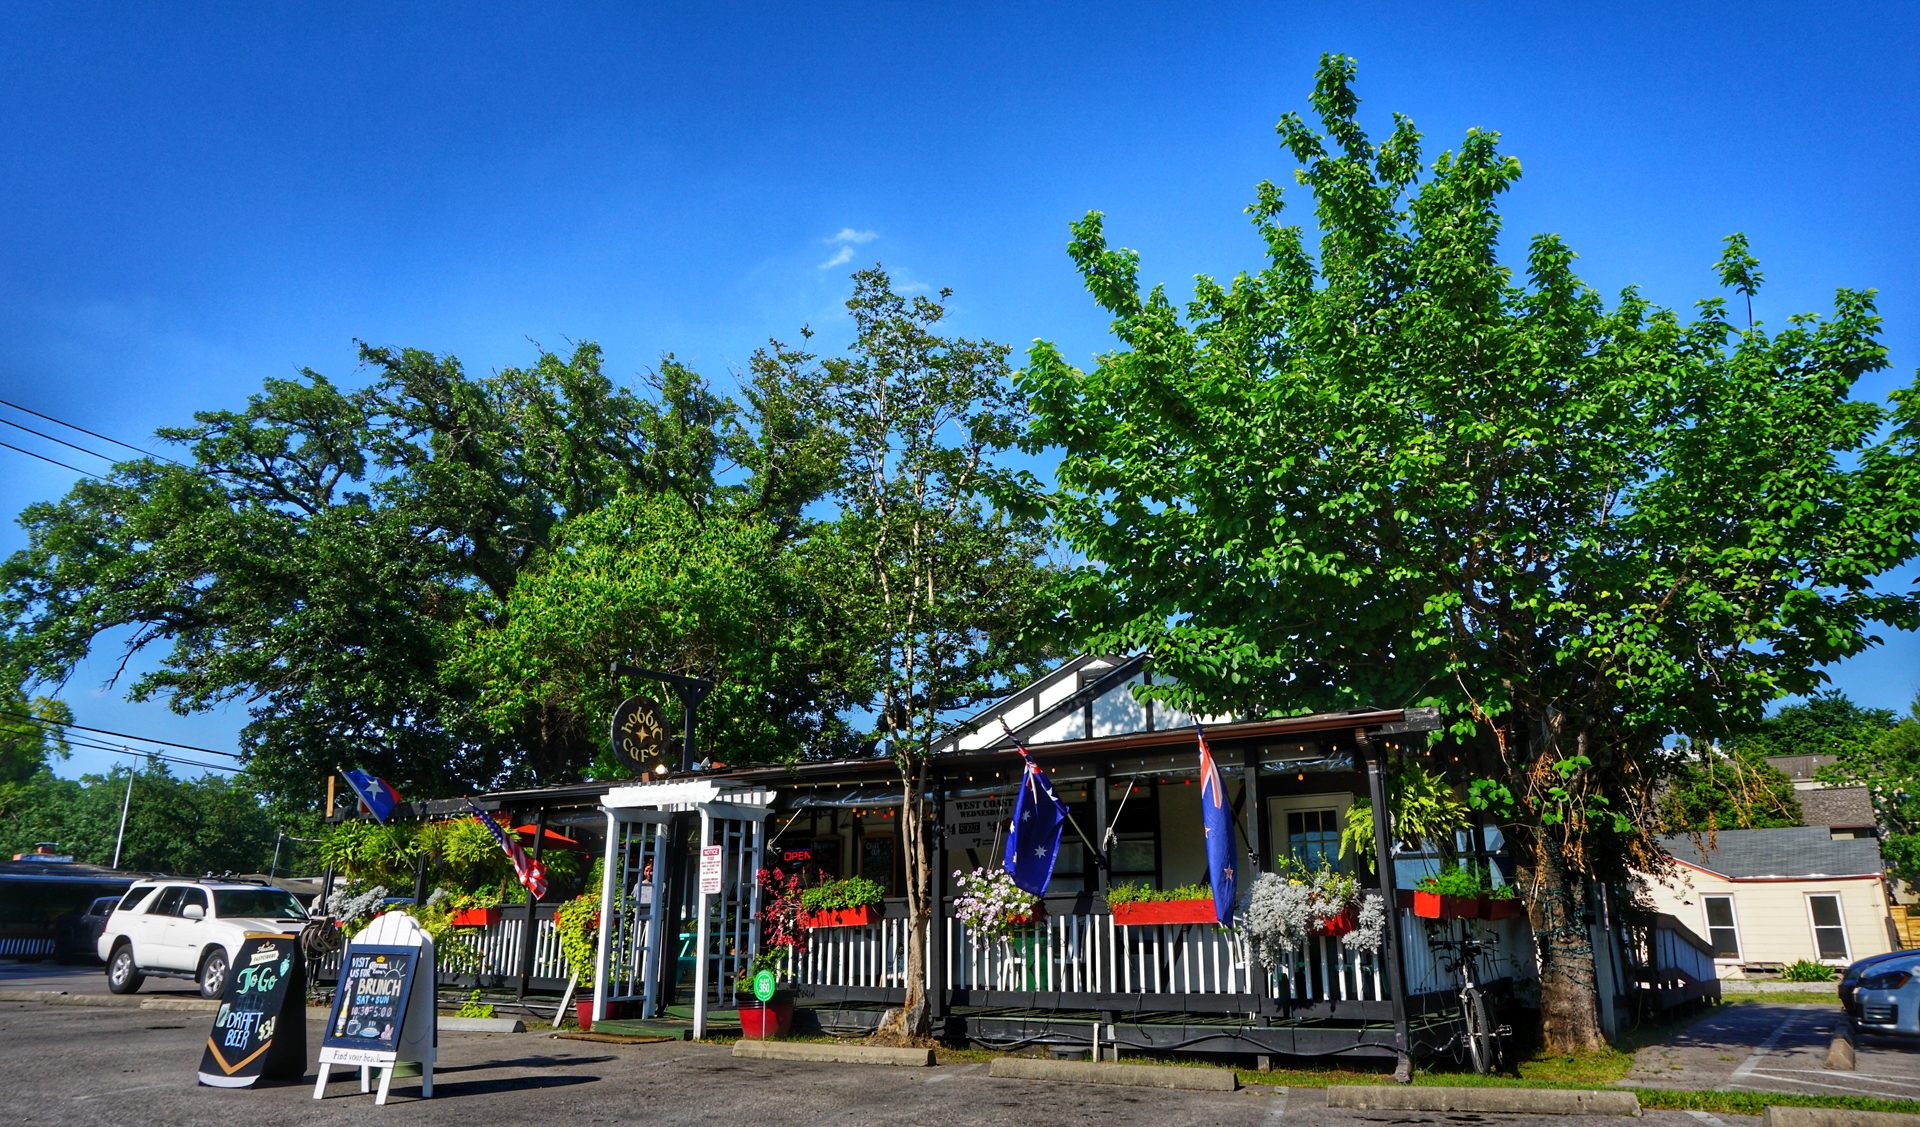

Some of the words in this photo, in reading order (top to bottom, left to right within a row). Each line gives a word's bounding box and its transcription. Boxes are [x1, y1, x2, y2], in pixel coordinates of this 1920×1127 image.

[956, 801, 981, 810] WEST
[783, 851, 811, 861] OPEN
[351, 957, 371, 968] VISIT
[350, 968, 359, 978] US
[359, 968, 371, 978] FOR
[357, 978, 402, 997] BRUNCH
[356, 995, 370, 1005] SAT
[374, 995, 390, 1005] SUN
[226, 1011, 264, 1034] DRAFT
[225, 1029, 250, 1050] BEER
[333, 1050, 347, 1060] Find
[348, 1053, 363, 1063] your
[363, 1053, 381, 1063] beach
